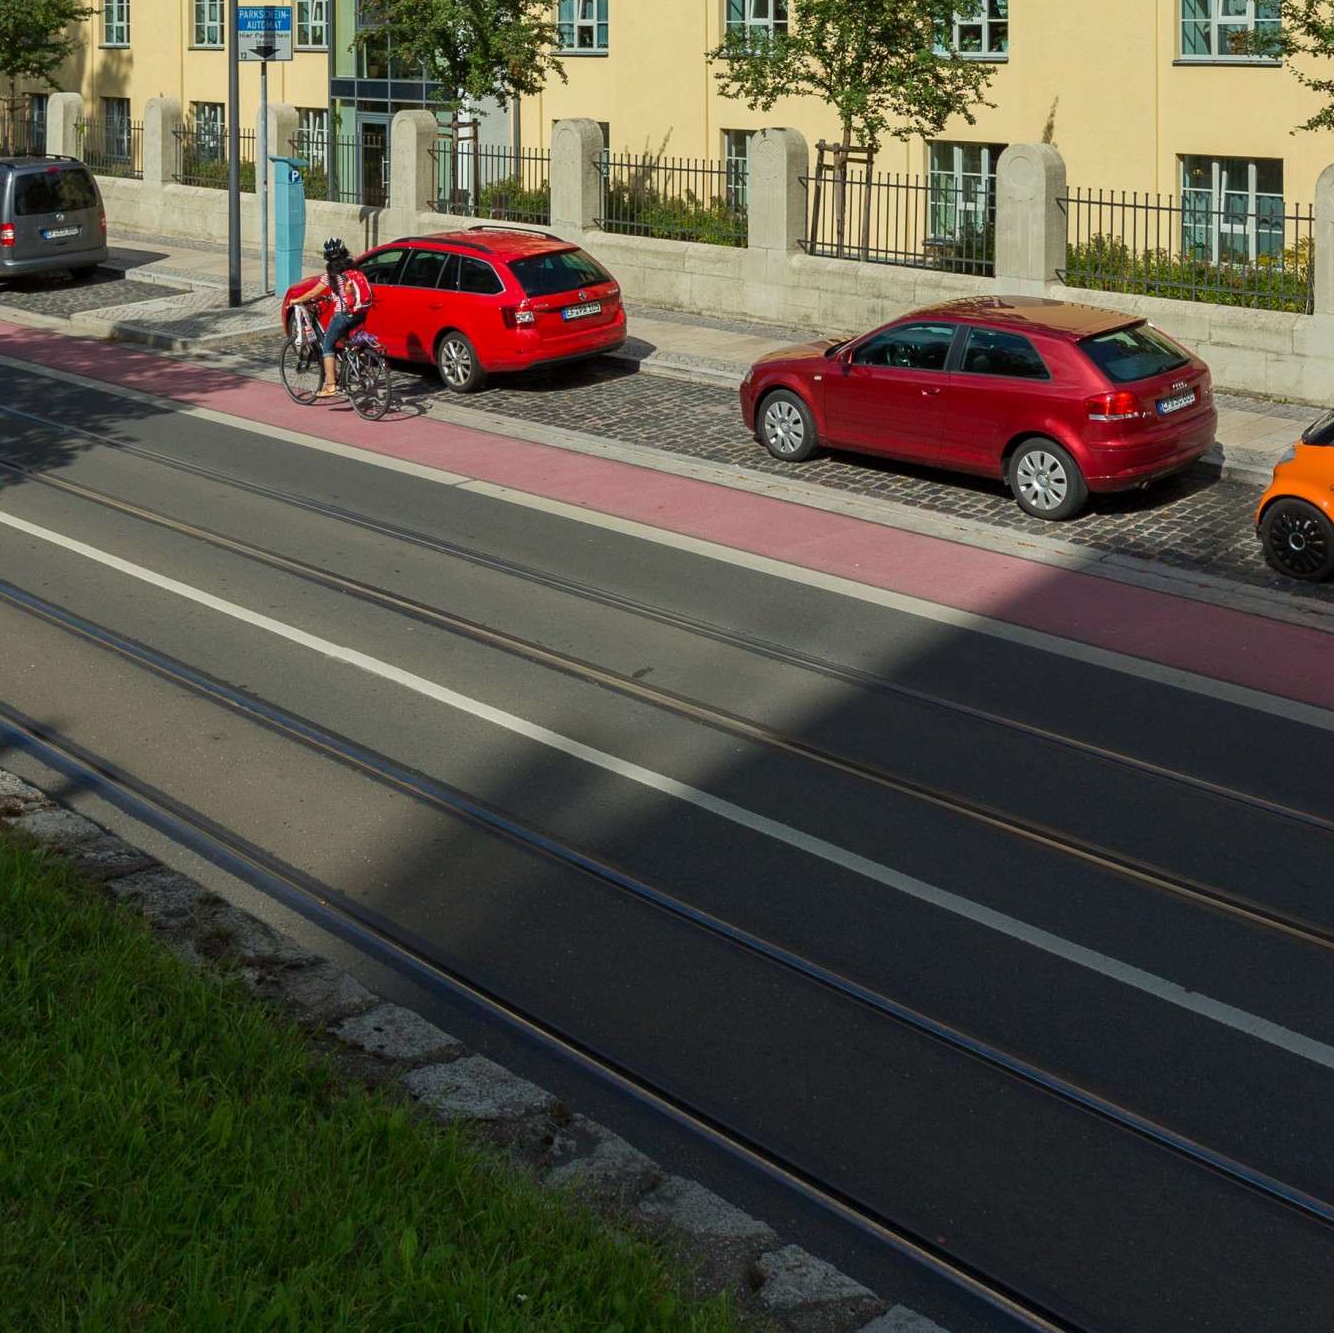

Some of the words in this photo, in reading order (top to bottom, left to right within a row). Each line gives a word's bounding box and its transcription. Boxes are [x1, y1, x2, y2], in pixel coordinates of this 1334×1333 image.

[239, 9, 290, 19] PARKSCHEIN-
[247, 20, 282, 29] AUTOMAT
[291, 170, 299, 182] P
